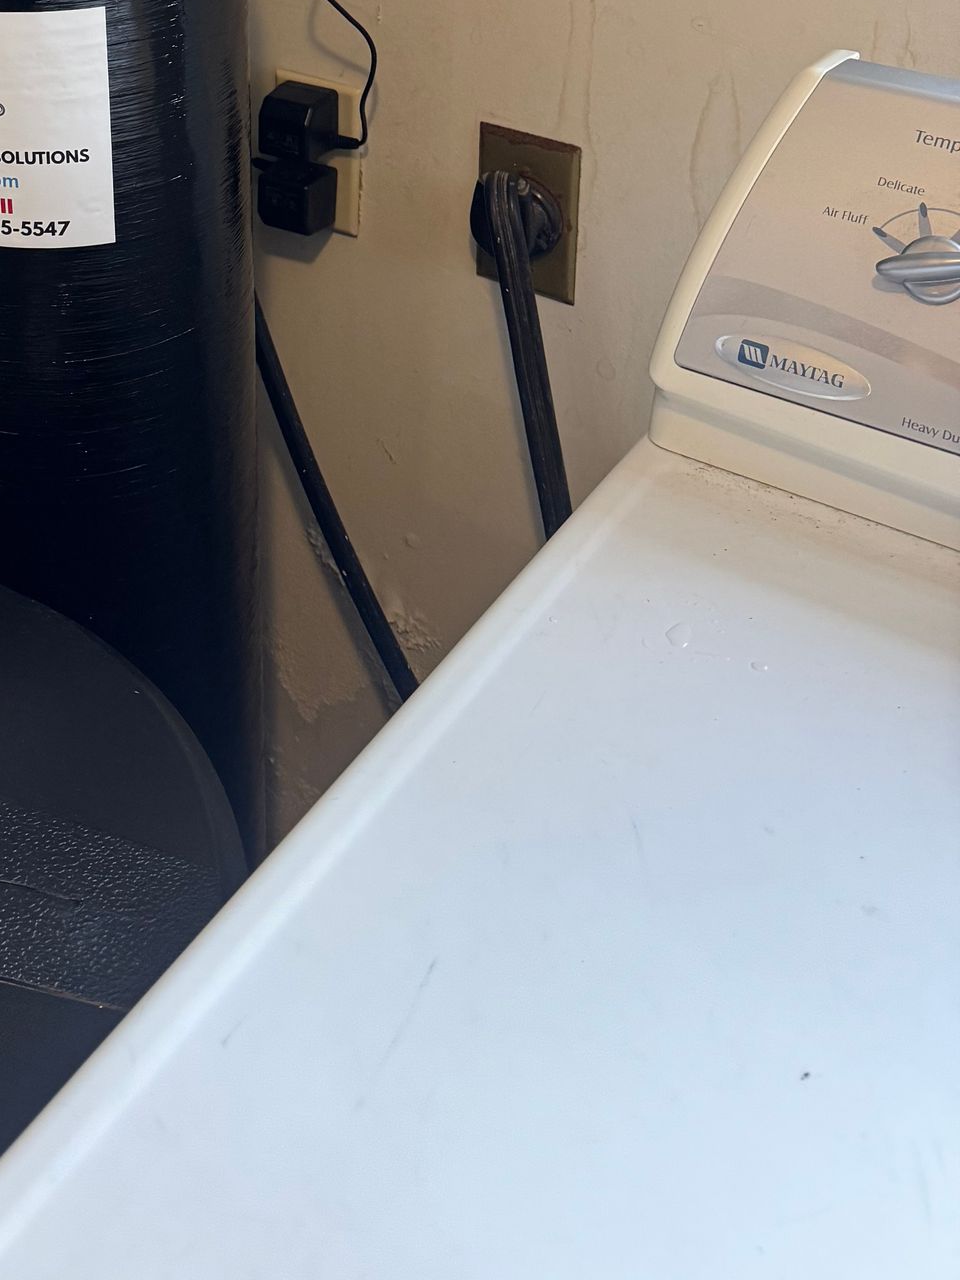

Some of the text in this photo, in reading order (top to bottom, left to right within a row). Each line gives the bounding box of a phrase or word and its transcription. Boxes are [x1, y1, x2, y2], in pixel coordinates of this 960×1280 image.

[877, 176, 925, 196] Delicate
[822, 206, 869, 225] Air Fluff
[769, 354, 845, 389] MAYTAG
[902, 417, 939, 439] Heavy
